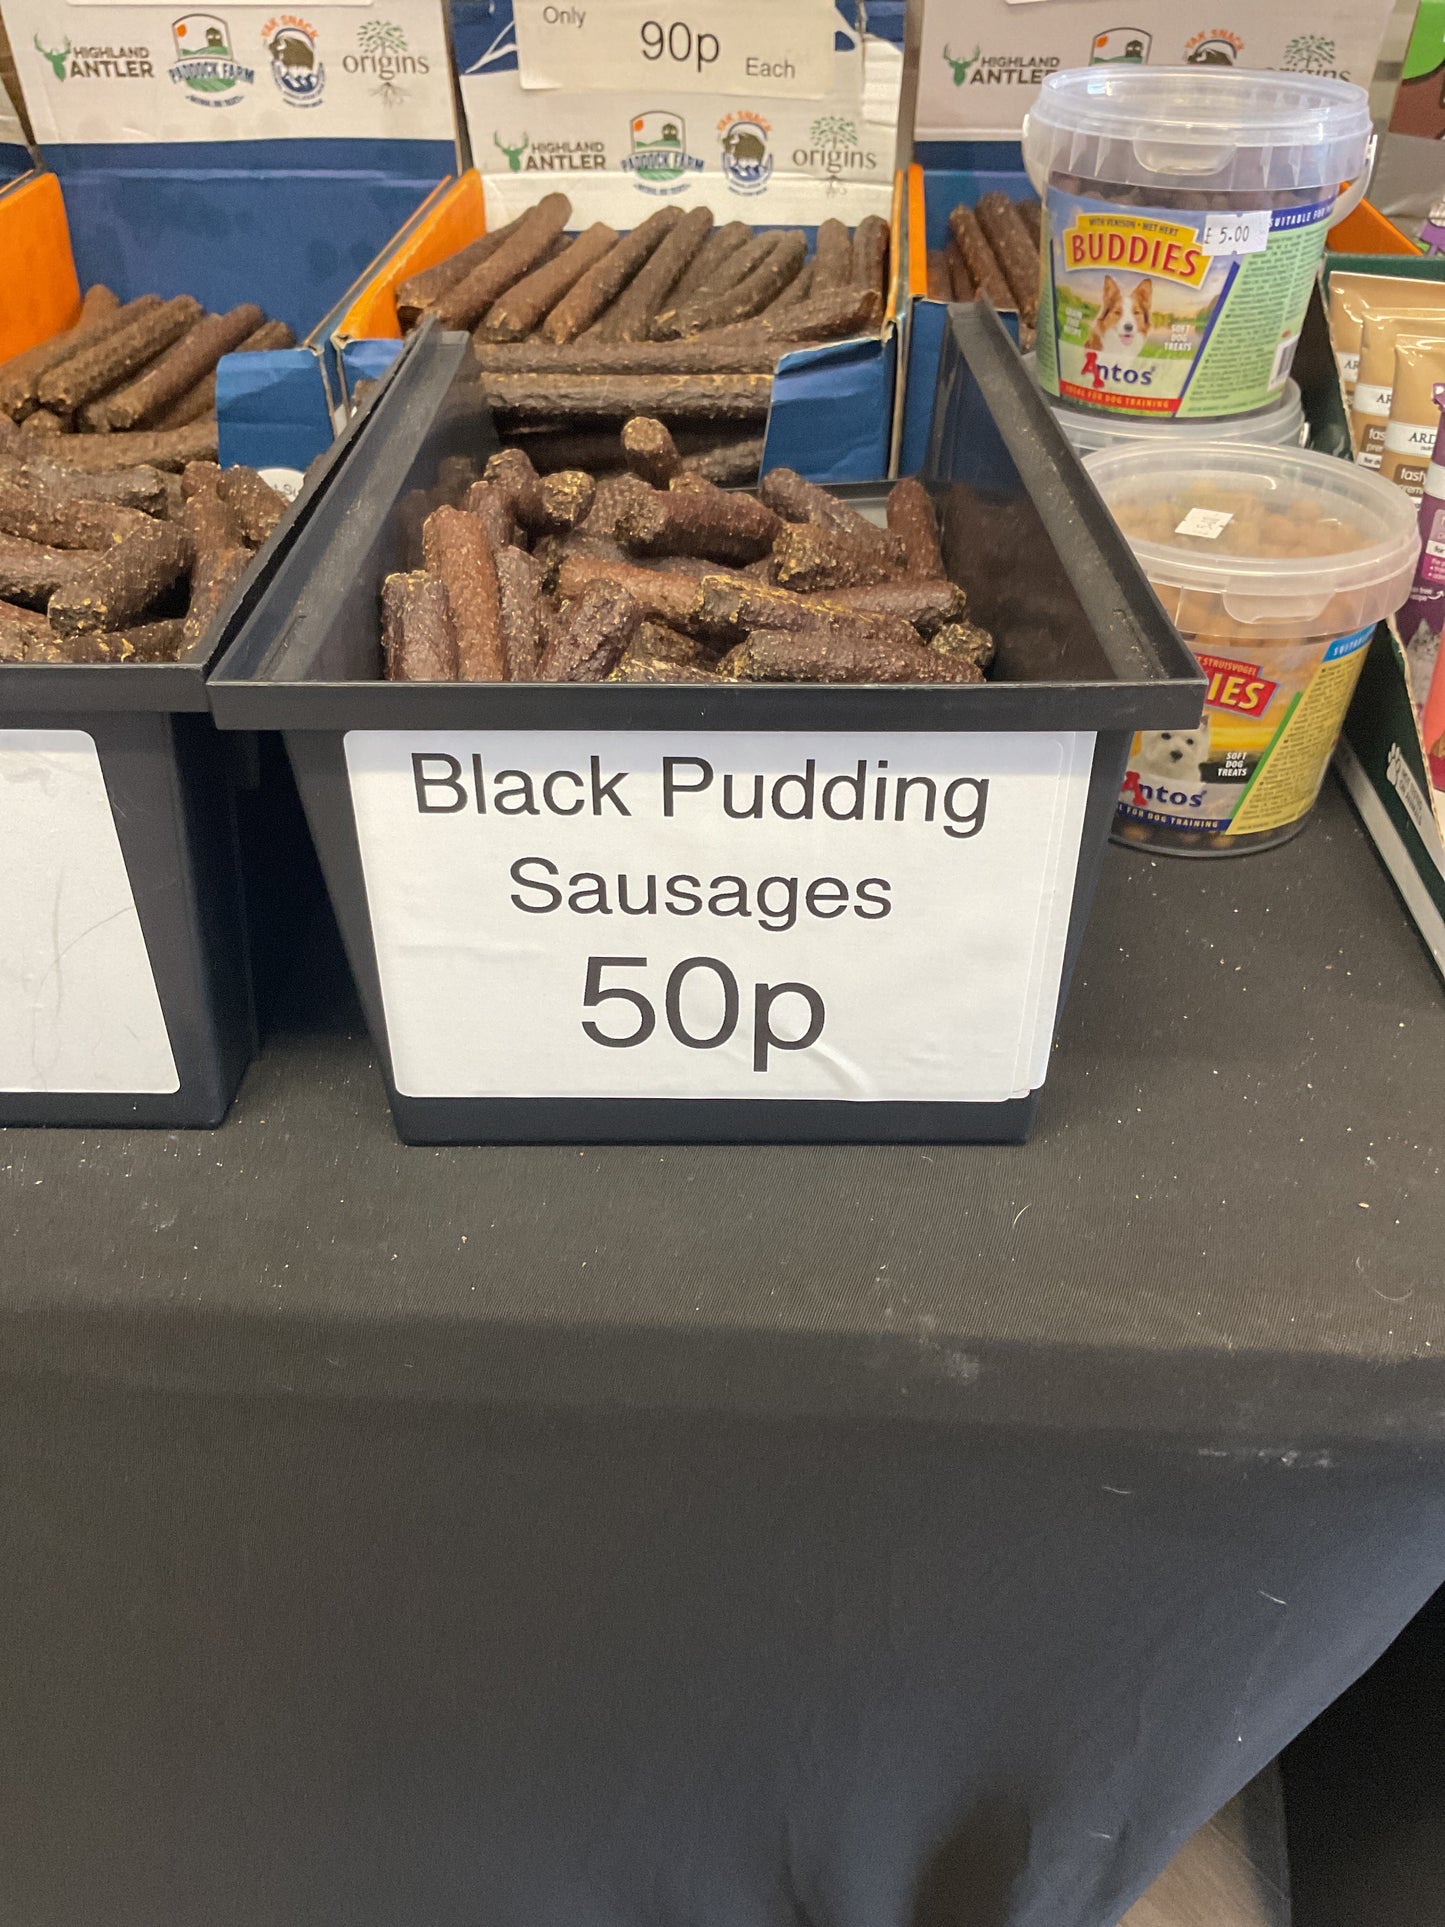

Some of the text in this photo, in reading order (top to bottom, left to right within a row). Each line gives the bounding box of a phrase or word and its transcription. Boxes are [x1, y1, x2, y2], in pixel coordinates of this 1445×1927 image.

[543, 6, 586, 28] Only
[73, 46, 150, 59] HIGHLAND
[640, 21, 720, 72] 90p
[70, 60, 154, 78] ANTLER
[343, 51, 430, 81] origins
[745, 57, 796, 79] Each
[981, 56, 1060, 68] HIGHLAND
[531, 142, 605, 154] HIGHLAND
[526, 155, 607, 170] ANTLER
[792, 145, 878, 173] origins
[1071, 232, 1202, 278] BUDDIES
[1171, 324, 1191, 334] SOFT
[1171, 334, 1188, 342] DOG
[1164, 342, 1192, 351] TREATS
[1081, 352, 1153, 388] Antos
[1125, 398, 1169, 408] TRAINING
[1225, 760, 1243, 768] DOG
[1226, 752, 1247, 760] SOFT
[1218, 768, 1247, 777] TREATS
[411, 751, 991, 839] Black Pudding
[1122, 771, 1203, 807] Antos
[1127, 806, 1144, 818] FOR
[1147, 812, 1166, 823] DOG
[1170, 817, 1219, 828] TRAINING
[508, 855, 893, 933] Sausages
[580, 955, 827, 1072] 50p
